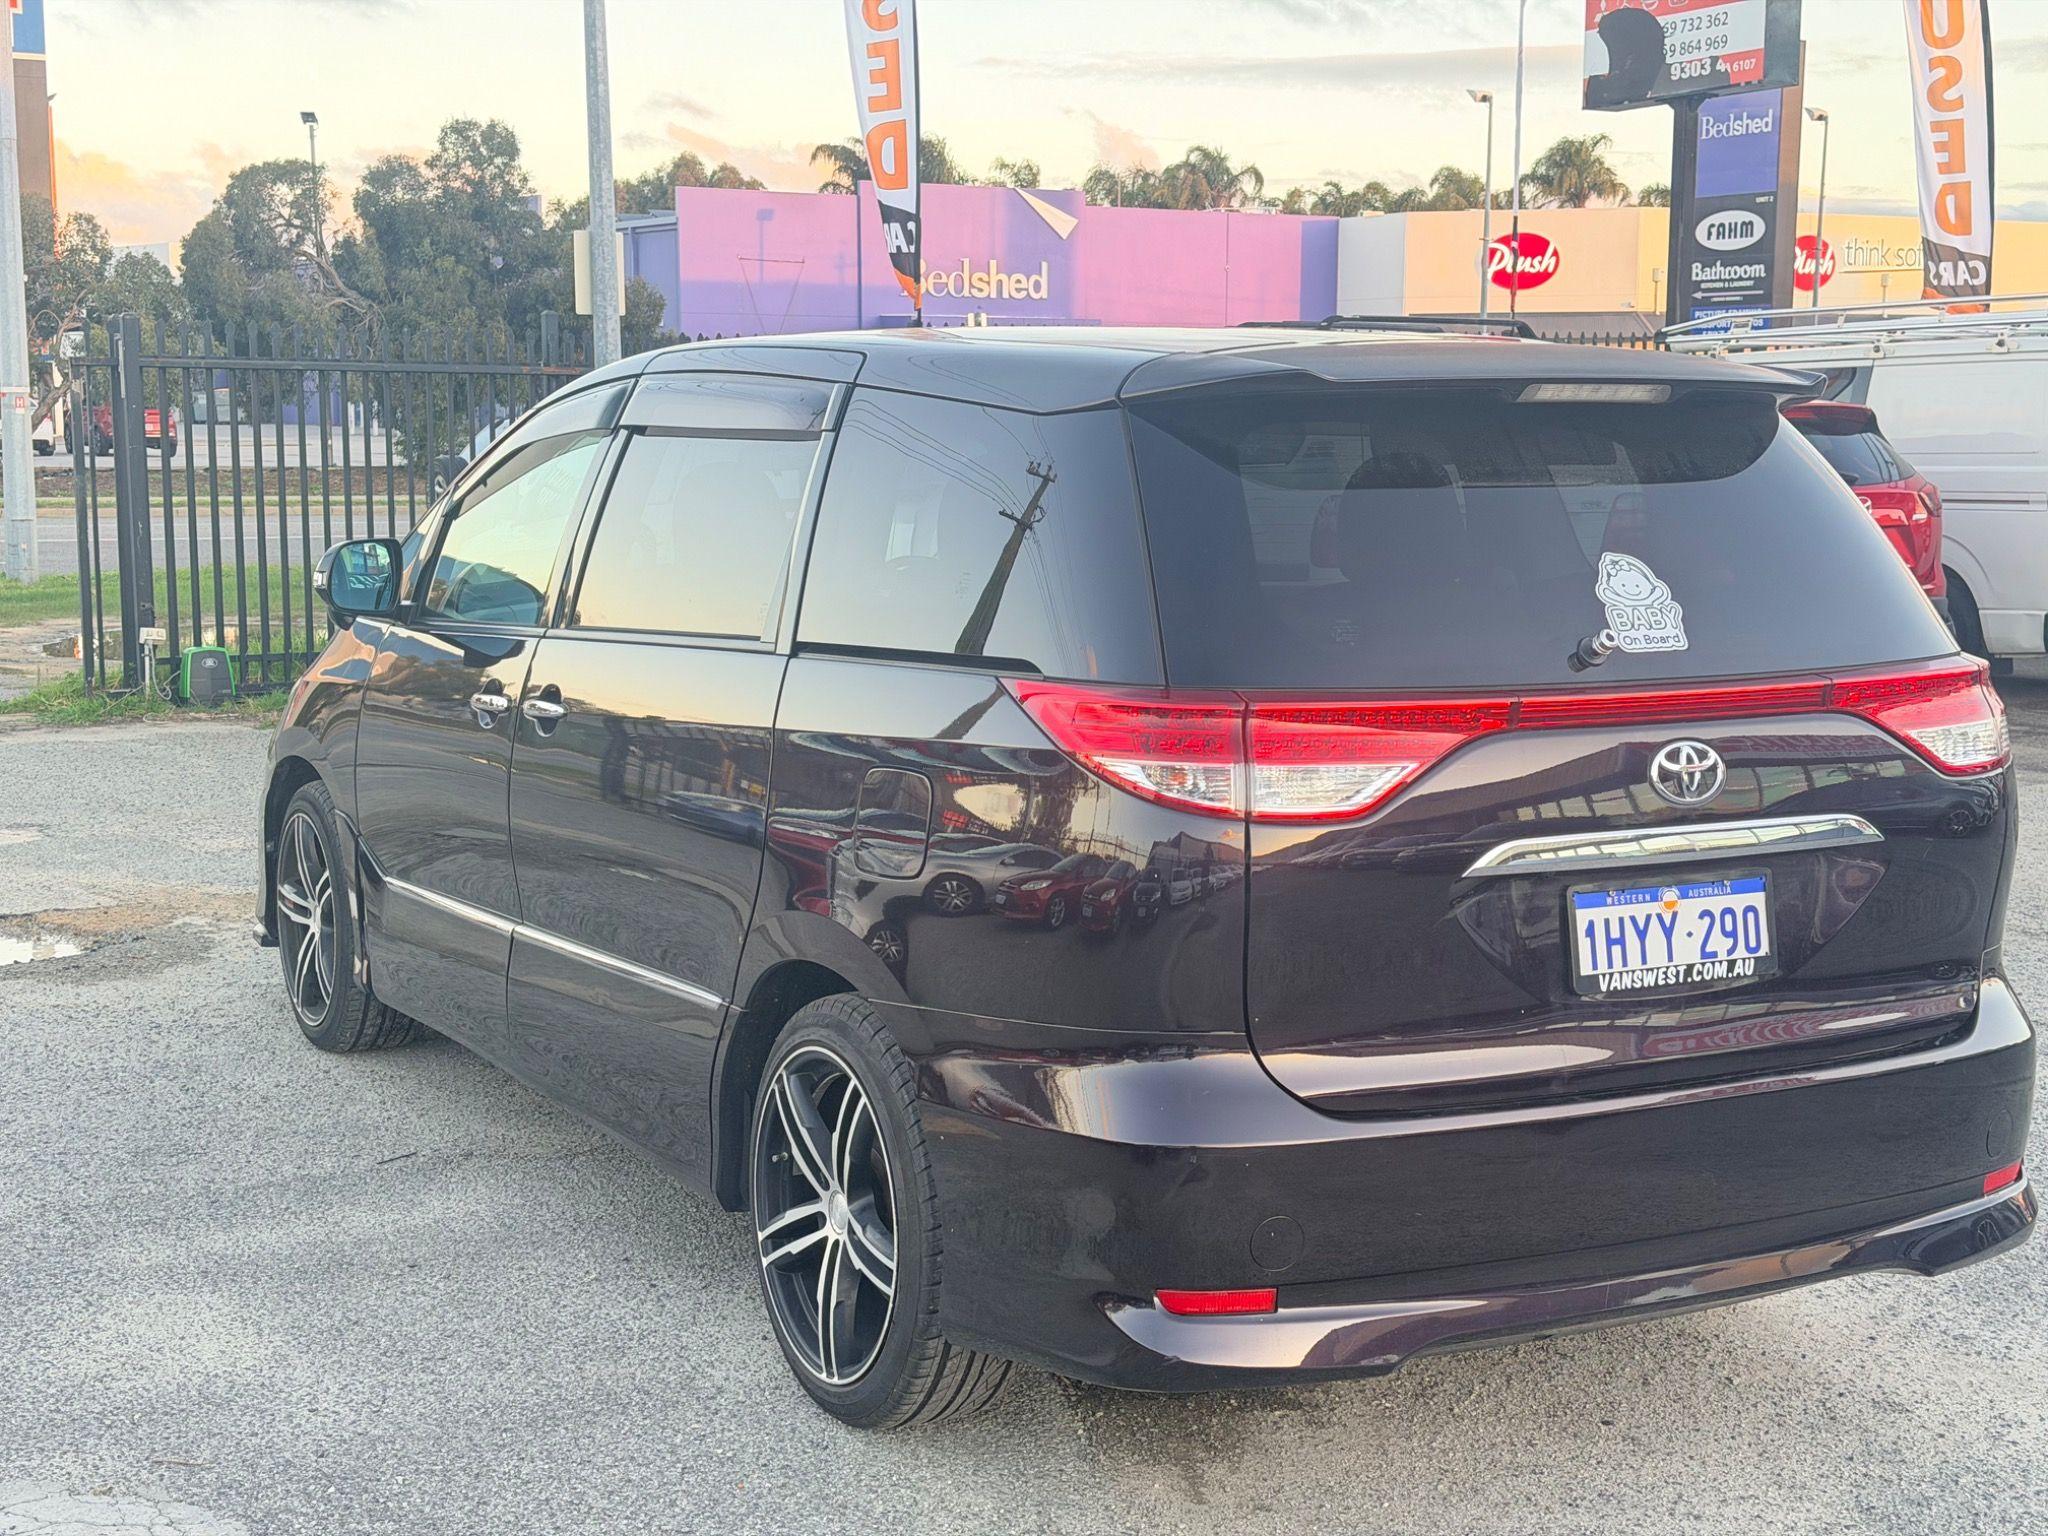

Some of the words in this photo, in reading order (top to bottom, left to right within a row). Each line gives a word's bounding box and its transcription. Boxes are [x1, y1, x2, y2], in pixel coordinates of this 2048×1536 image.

[1680, 17, 1702, 34] 732
[1705, 11, 1729, 29] 362
[1679, 38, 1702, 56] 864
[1705, 34, 1728, 53] 969
[1670, 58, 1711, 80] 9303
[1732, 57, 1756, 73] 6107
[1701, 108, 1773, 140] Bedshed
[1707, 220, 1754, 241] FAHM
[1794, 245, 1834, 276] lush
[1845, 238, 1890, 268] think
[1691, 260, 1766, 281] Bathroom
[1611, 606, 1678, 631] BABY
[1622, 635, 1642, 646] On
[1643, 634, 1680, 645] Board
[1606, 893, 1651, 905] WESTERN
[1688, 884, 1733, 898] AUSTRALIA
[1599, 957, 1755, 992] VANSWEST.COM.AU
